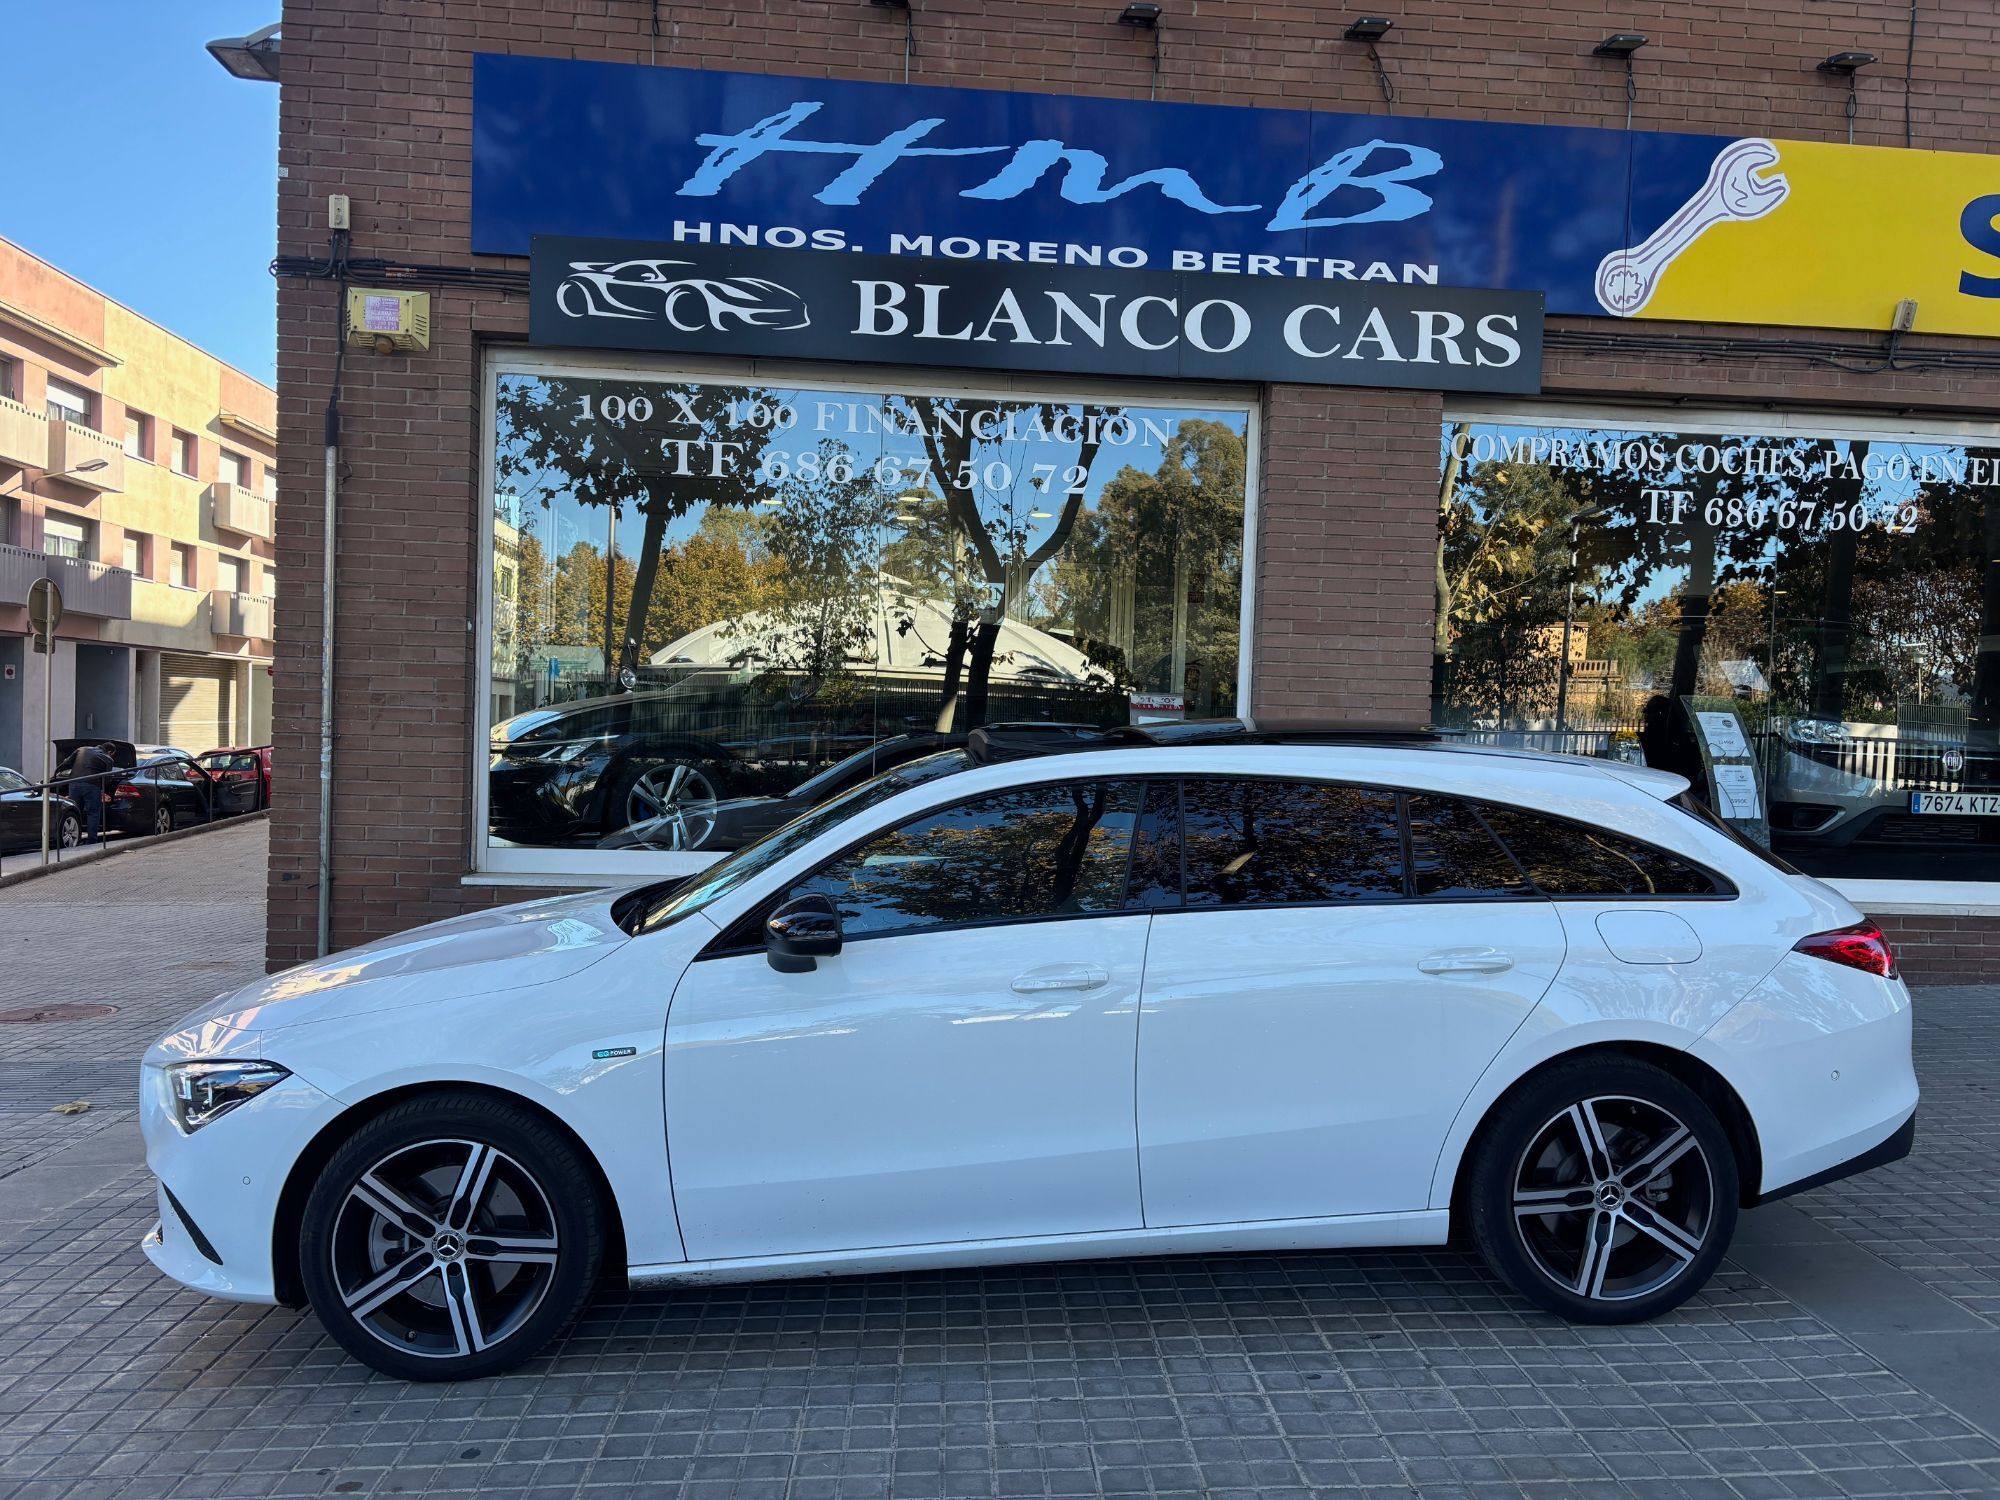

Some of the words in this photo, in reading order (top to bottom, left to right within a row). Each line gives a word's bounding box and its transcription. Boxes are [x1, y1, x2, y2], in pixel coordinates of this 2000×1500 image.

[673, 220, 863, 252] HNOS.
[890, 234, 1148, 269] MORENO
[1172, 251, 1439, 285] BERTRAN
[850, 279, 1251, 354] BLANCO
[1283, 304, 1522, 368] CARS
[578, 395, 653, 423] 100
[671, 394, 704, 425] X
[727, 401, 798, 430] 100
[661, 438, 744, 478] TF
[761, 451, 855, 484] 686
[874, 457, 932, 487] 67
[952, 460, 1012, 491] 50
[1032, 463, 1088, 494] 72
[1451, 432, 1666, 472] COMPRAMOS
[1824, 451, 1911, 482] PAGO
[1919, 455, 1961, 486] EN
[1641, 488, 1695, 525] TF
[1704, 498, 1765, 529] 686
[1779, 500, 1816, 531] 67
[1831, 503, 1868, 532] 50
[1881, 504, 1918, 534] 72
[1924, 796, 1963, 812] 7674
[1970, 797, 1998, 813] KTZ
